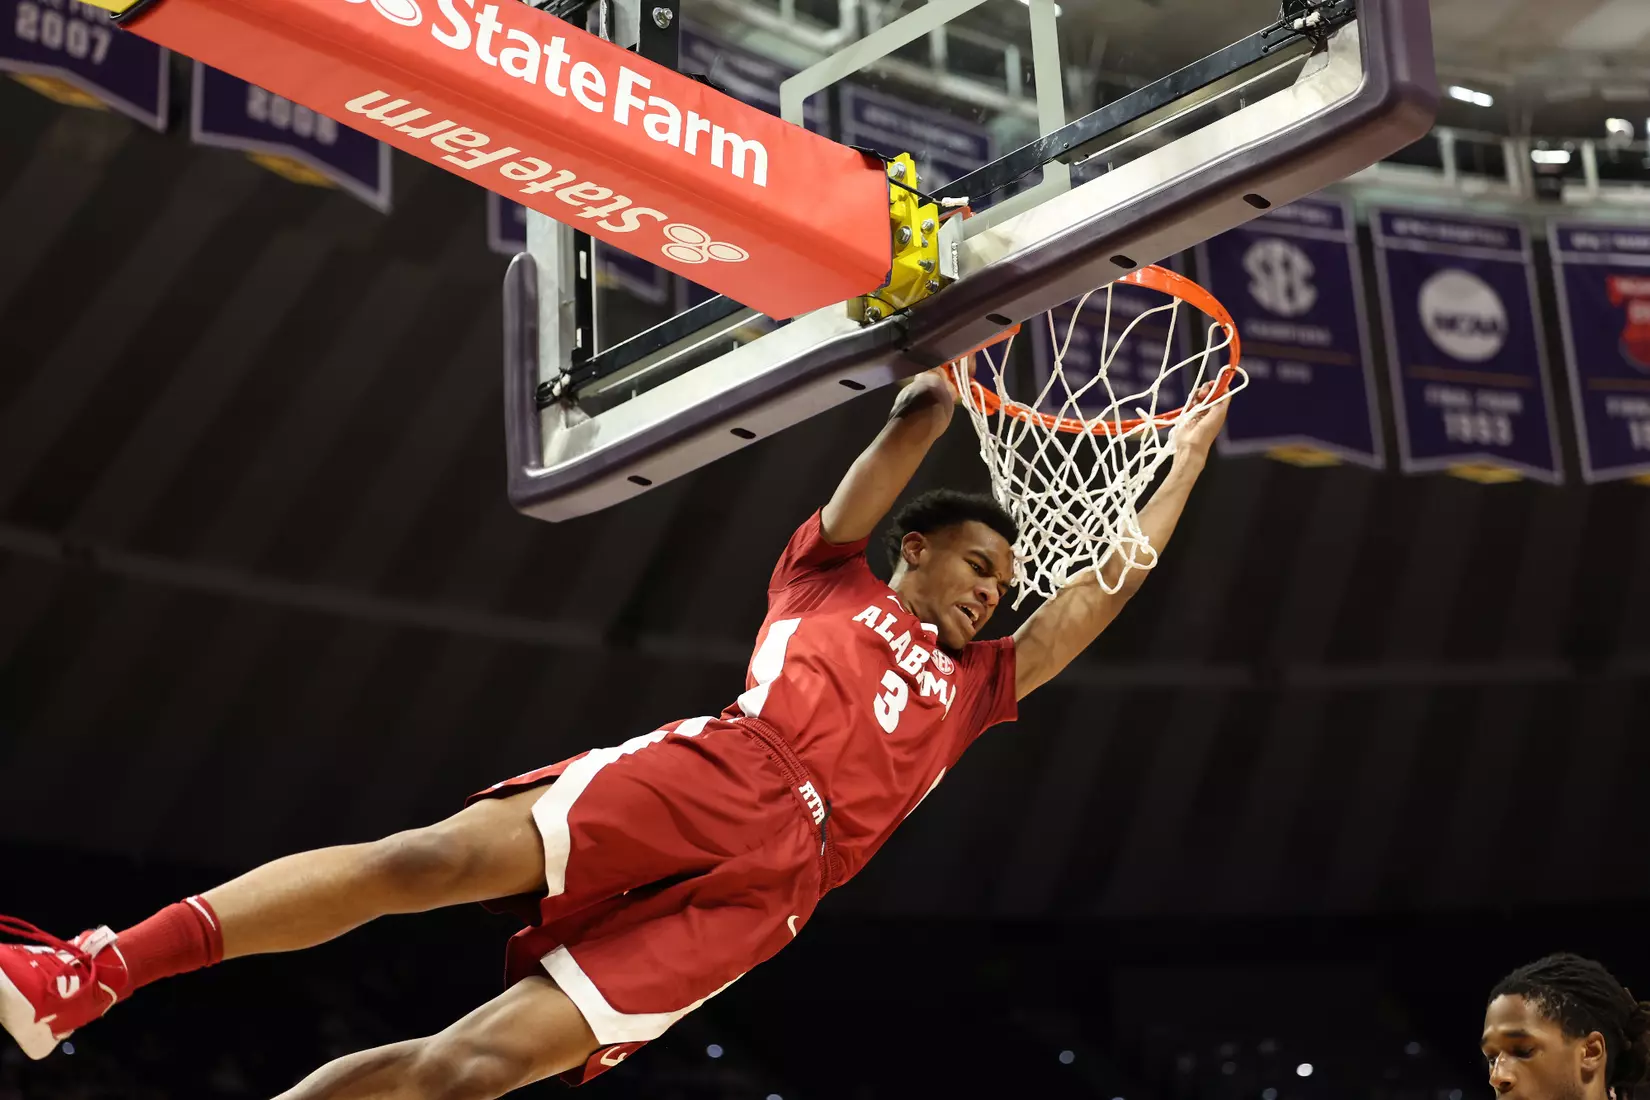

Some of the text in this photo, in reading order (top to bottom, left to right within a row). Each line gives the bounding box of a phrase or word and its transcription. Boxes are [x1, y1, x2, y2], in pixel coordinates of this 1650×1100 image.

[15, 1, 112, 66] 2007
[852, 605, 957, 721] ALABM
[873, 669, 909, 734] 3
[798, 780, 826, 826] RTR
